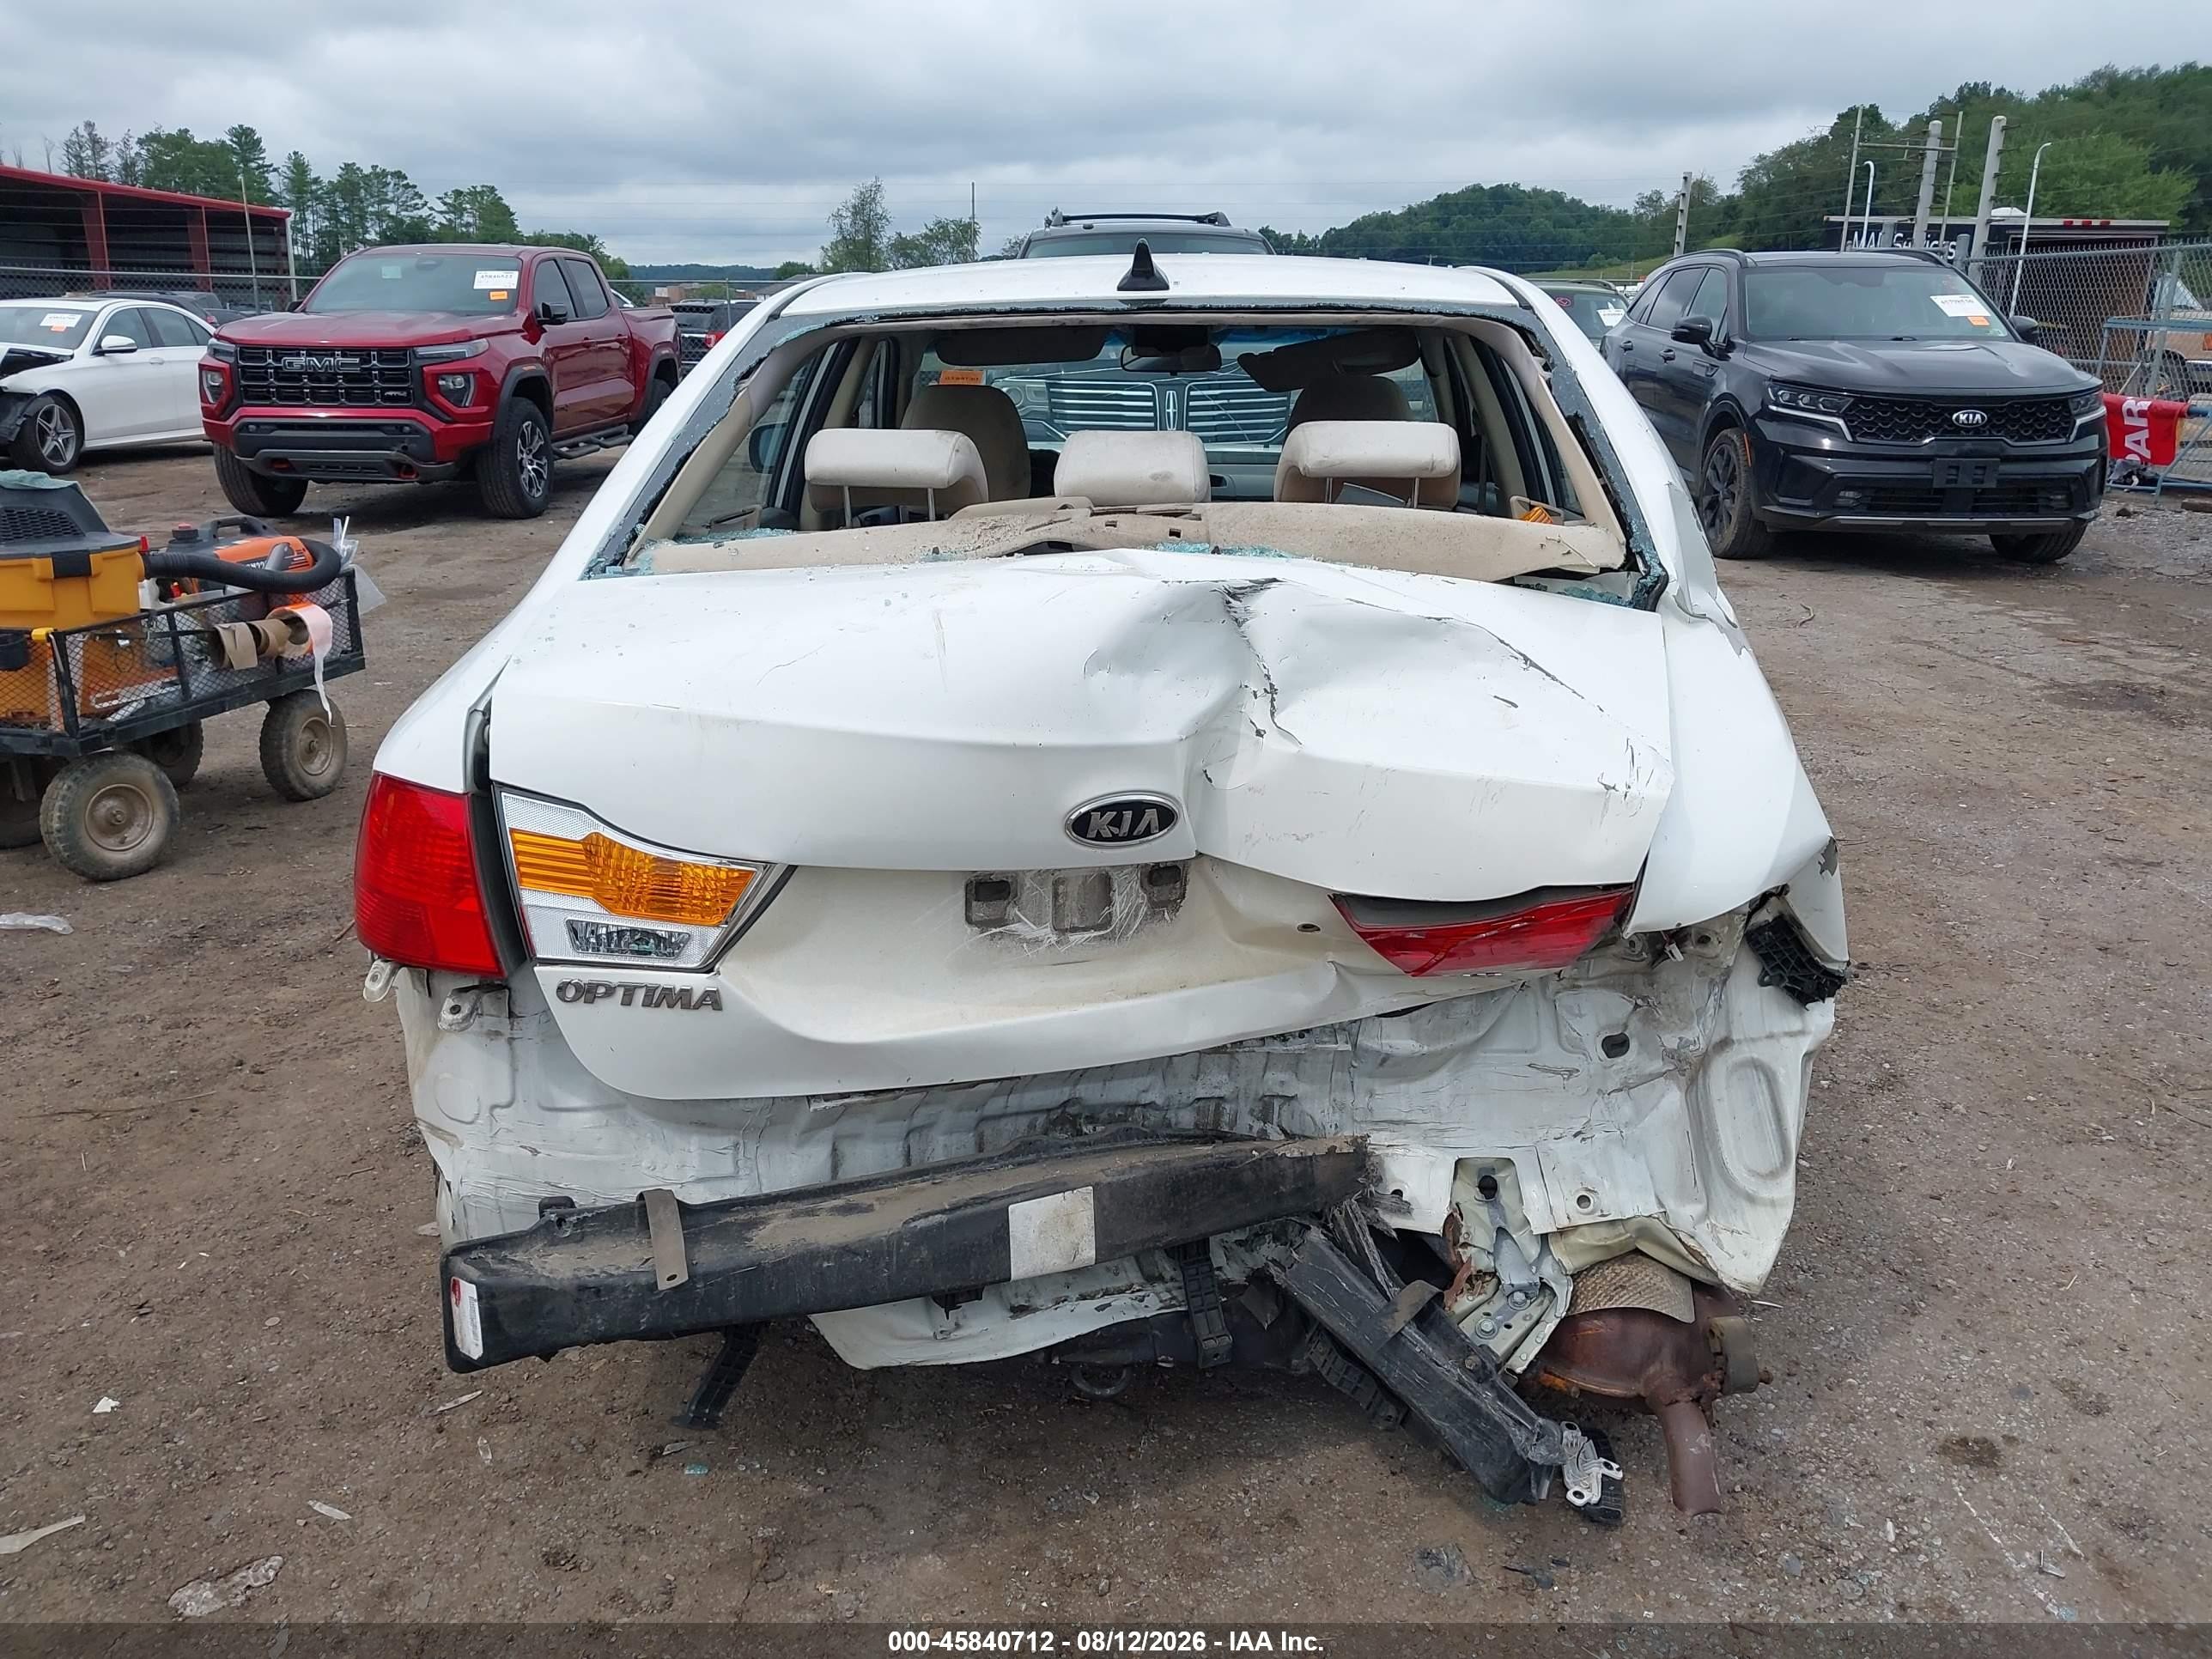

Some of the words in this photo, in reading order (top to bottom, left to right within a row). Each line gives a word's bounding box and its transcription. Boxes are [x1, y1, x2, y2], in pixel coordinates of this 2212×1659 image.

[282, 356, 361, 373] GMC
[1959, 413, 1982, 424] KIA
[1086, 808, 1160, 839] KIA
[556, 977, 723, 1012] OPTIMA
